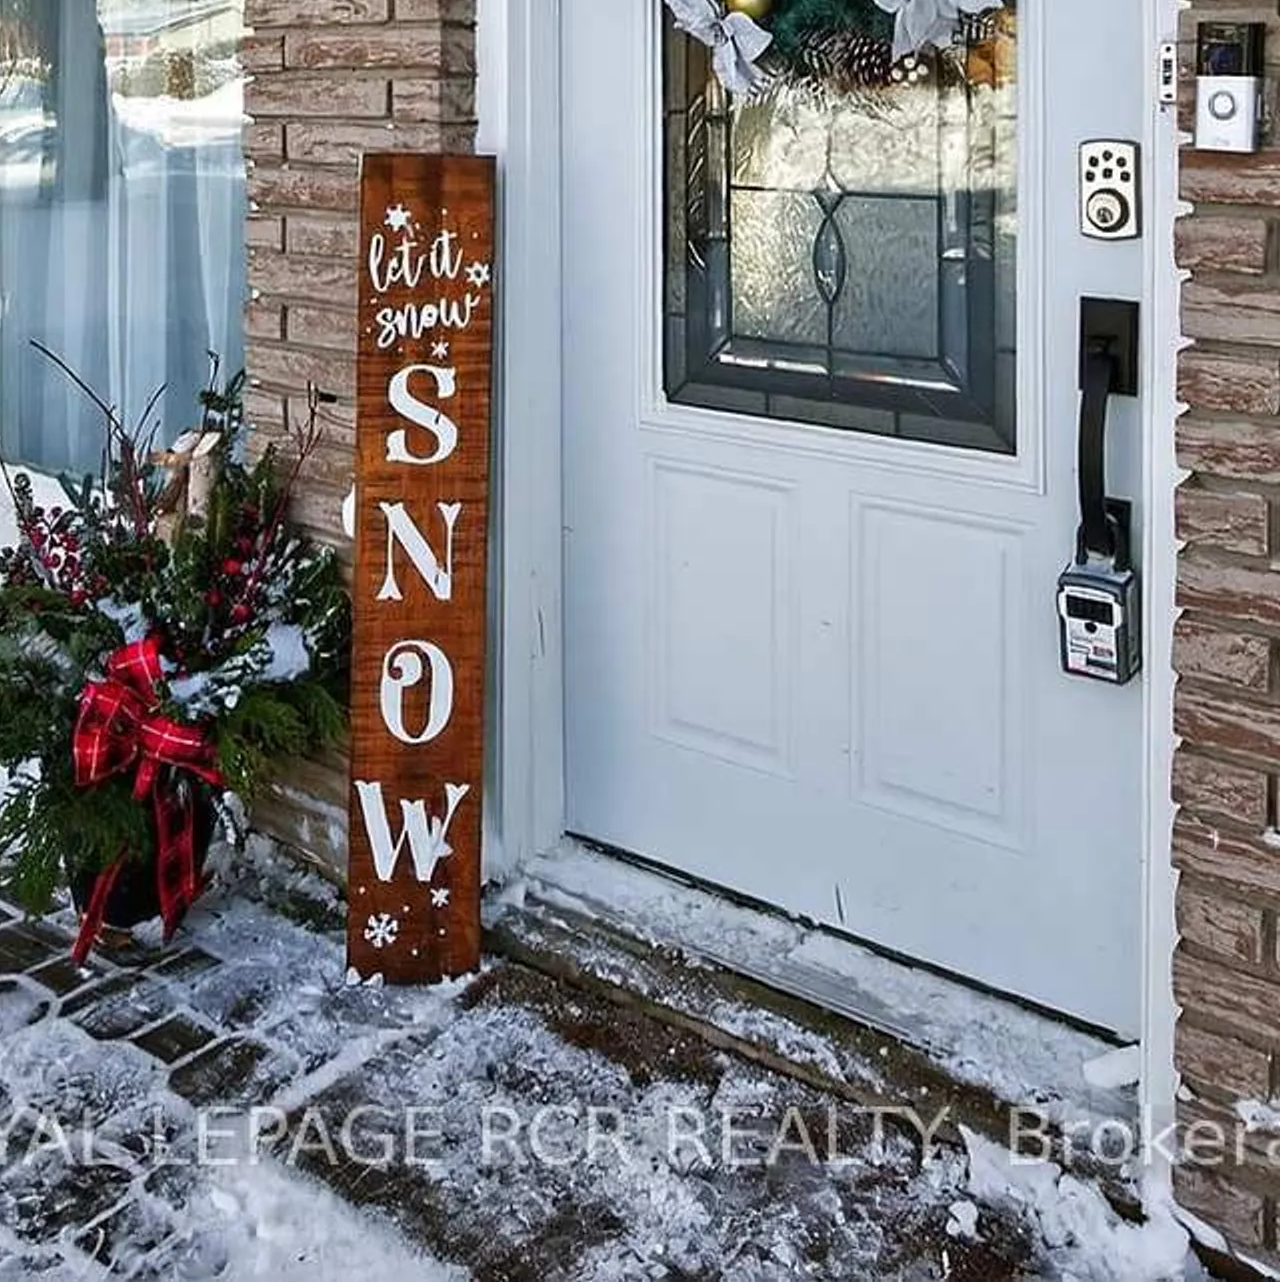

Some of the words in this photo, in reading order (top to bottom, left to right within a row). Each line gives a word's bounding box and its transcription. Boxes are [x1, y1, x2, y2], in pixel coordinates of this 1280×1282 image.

[370, 233, 426, 292] let
[430, 208, 463, 279] it
[376, 293, 481, 348] snow
[354, 364, 470, 882] SNOW
